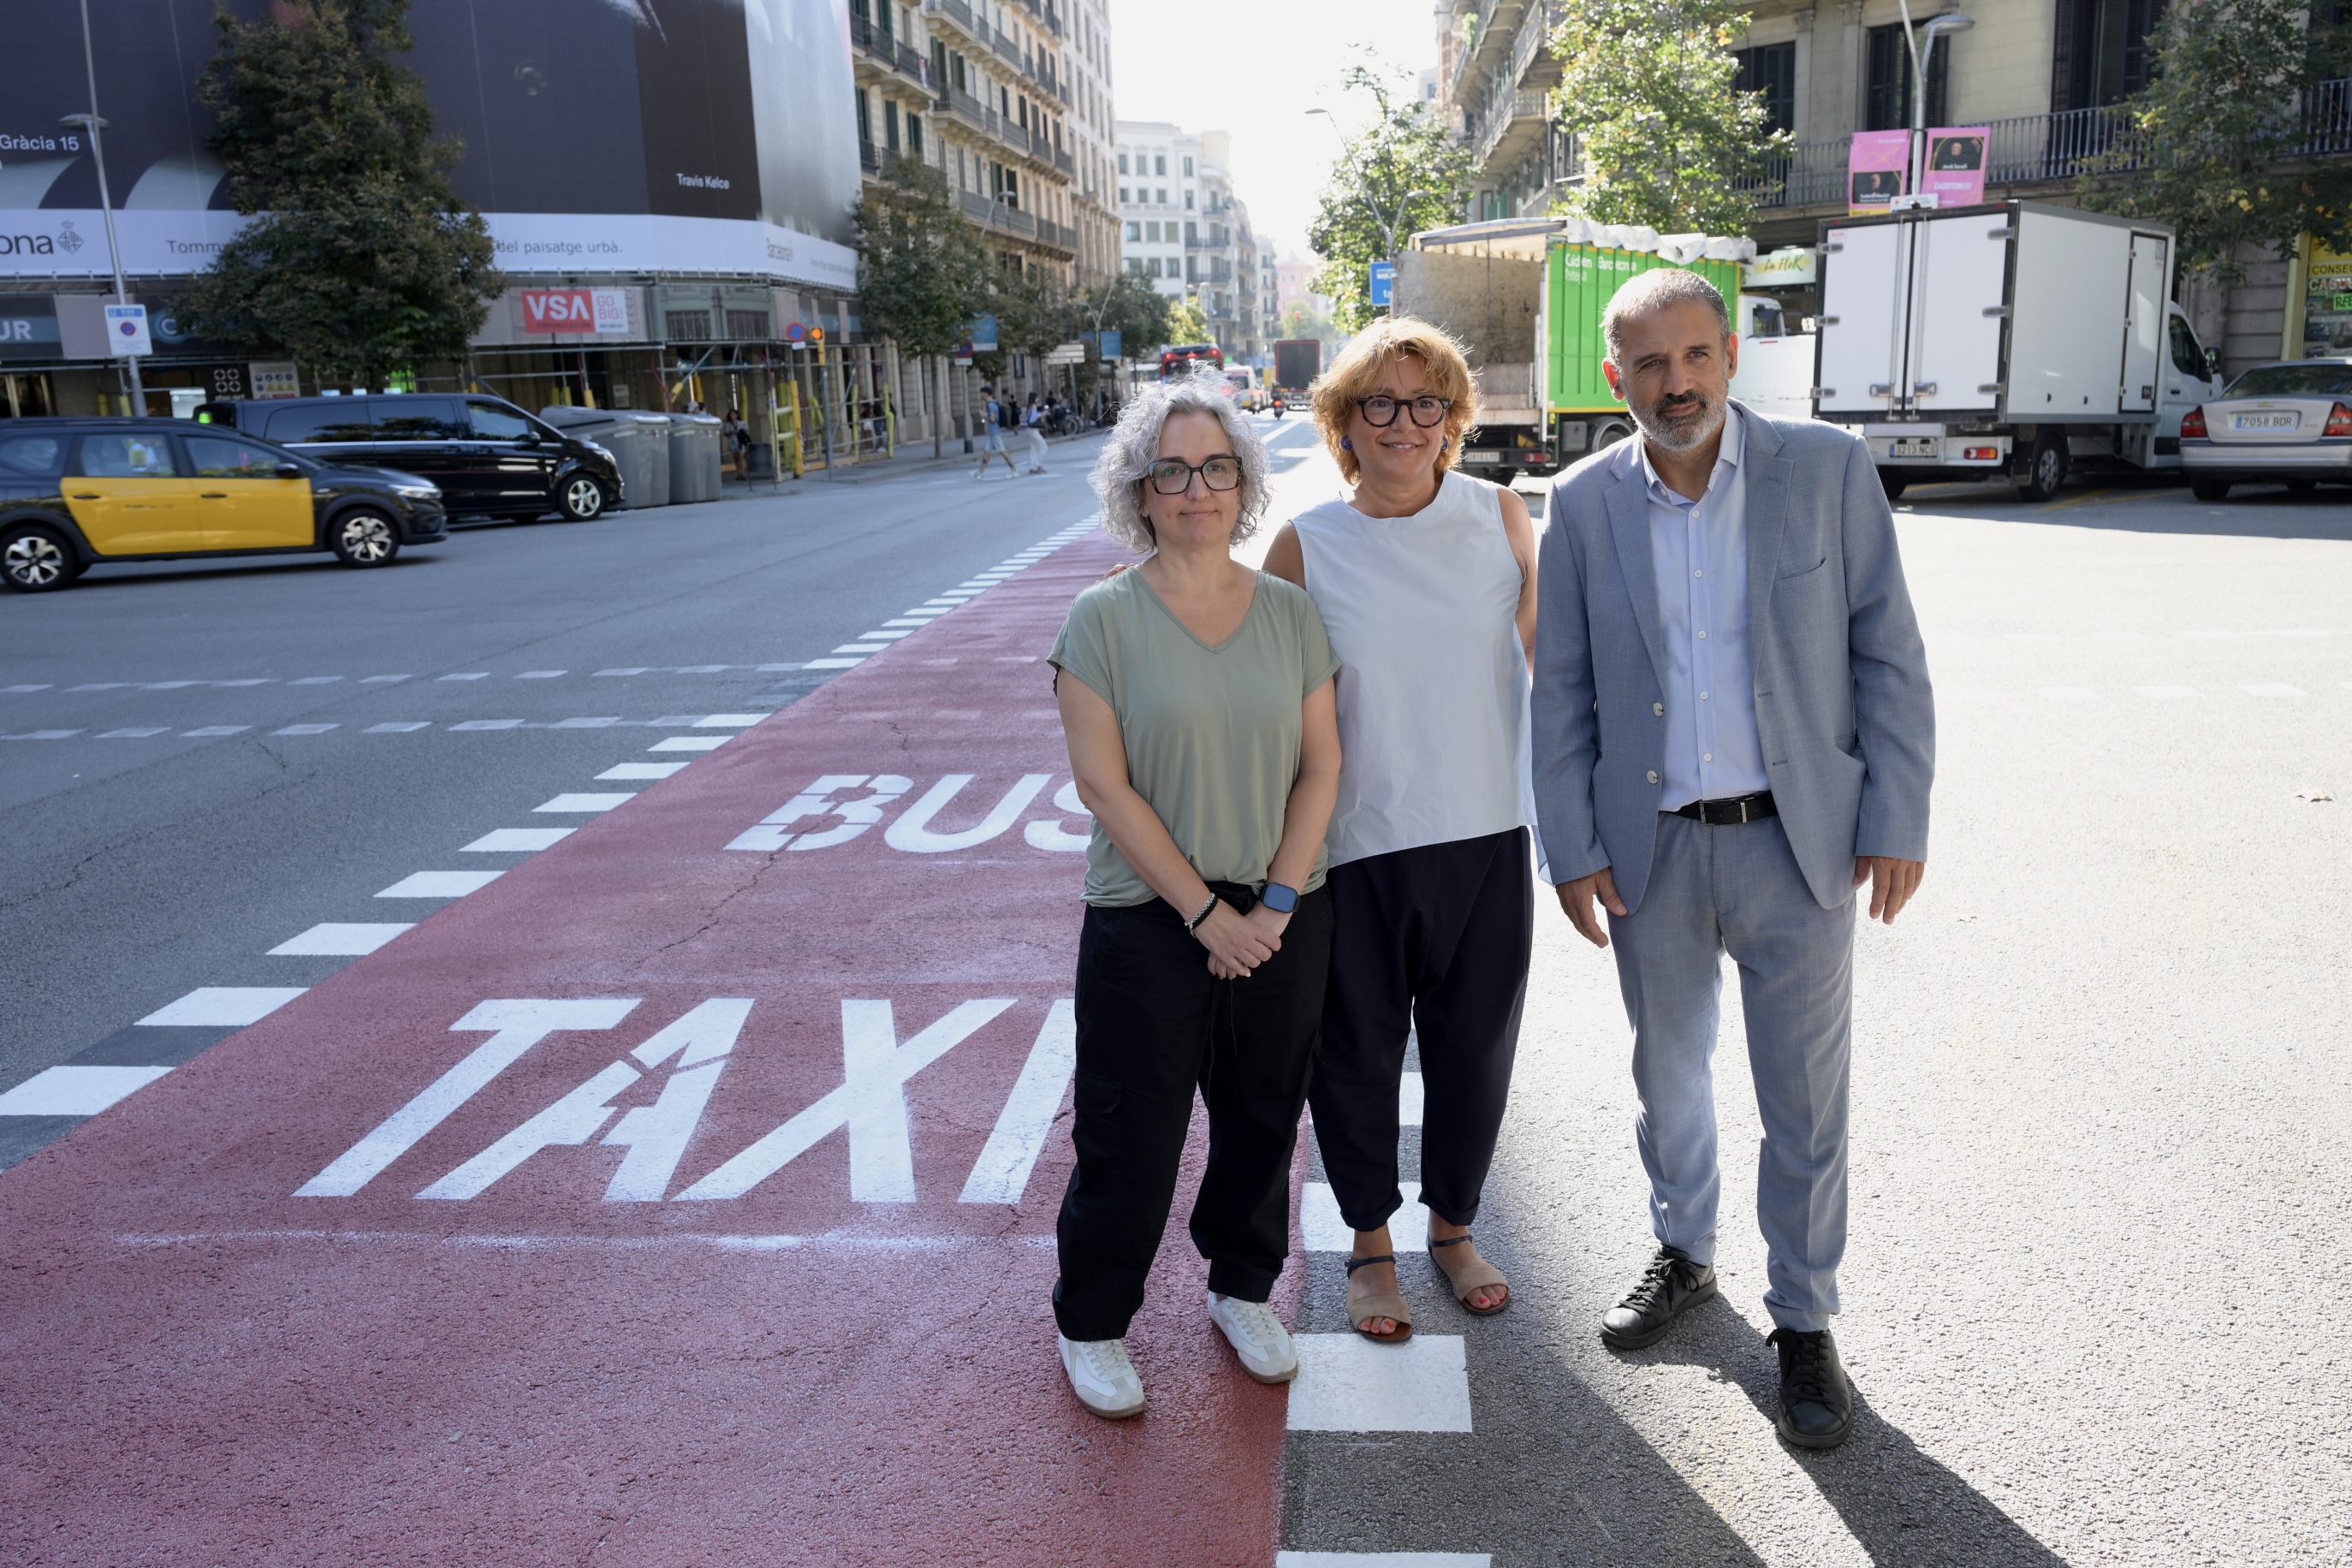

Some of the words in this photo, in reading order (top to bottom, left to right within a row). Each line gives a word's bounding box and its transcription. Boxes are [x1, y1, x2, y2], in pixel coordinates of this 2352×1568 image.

[0, 134, 56, 150] Gràcia
[59, 136, 80, 151] 15
[676, 173, 704, 187] Travis
[704, 175, 730, 190] Kelce
[495, 241, 520, 254] del
[524, 241, 583, 256] paisatge
[587, 241, 623, 253] urbà.
[597, 294, 615, 307] GO
[599, 307, 625, 320] BIG!
[2242, 416, 2270, 426] 7058
[2272, 416, 2293, 426] BDR
[289, 997, 1077, 1205] TAXI
